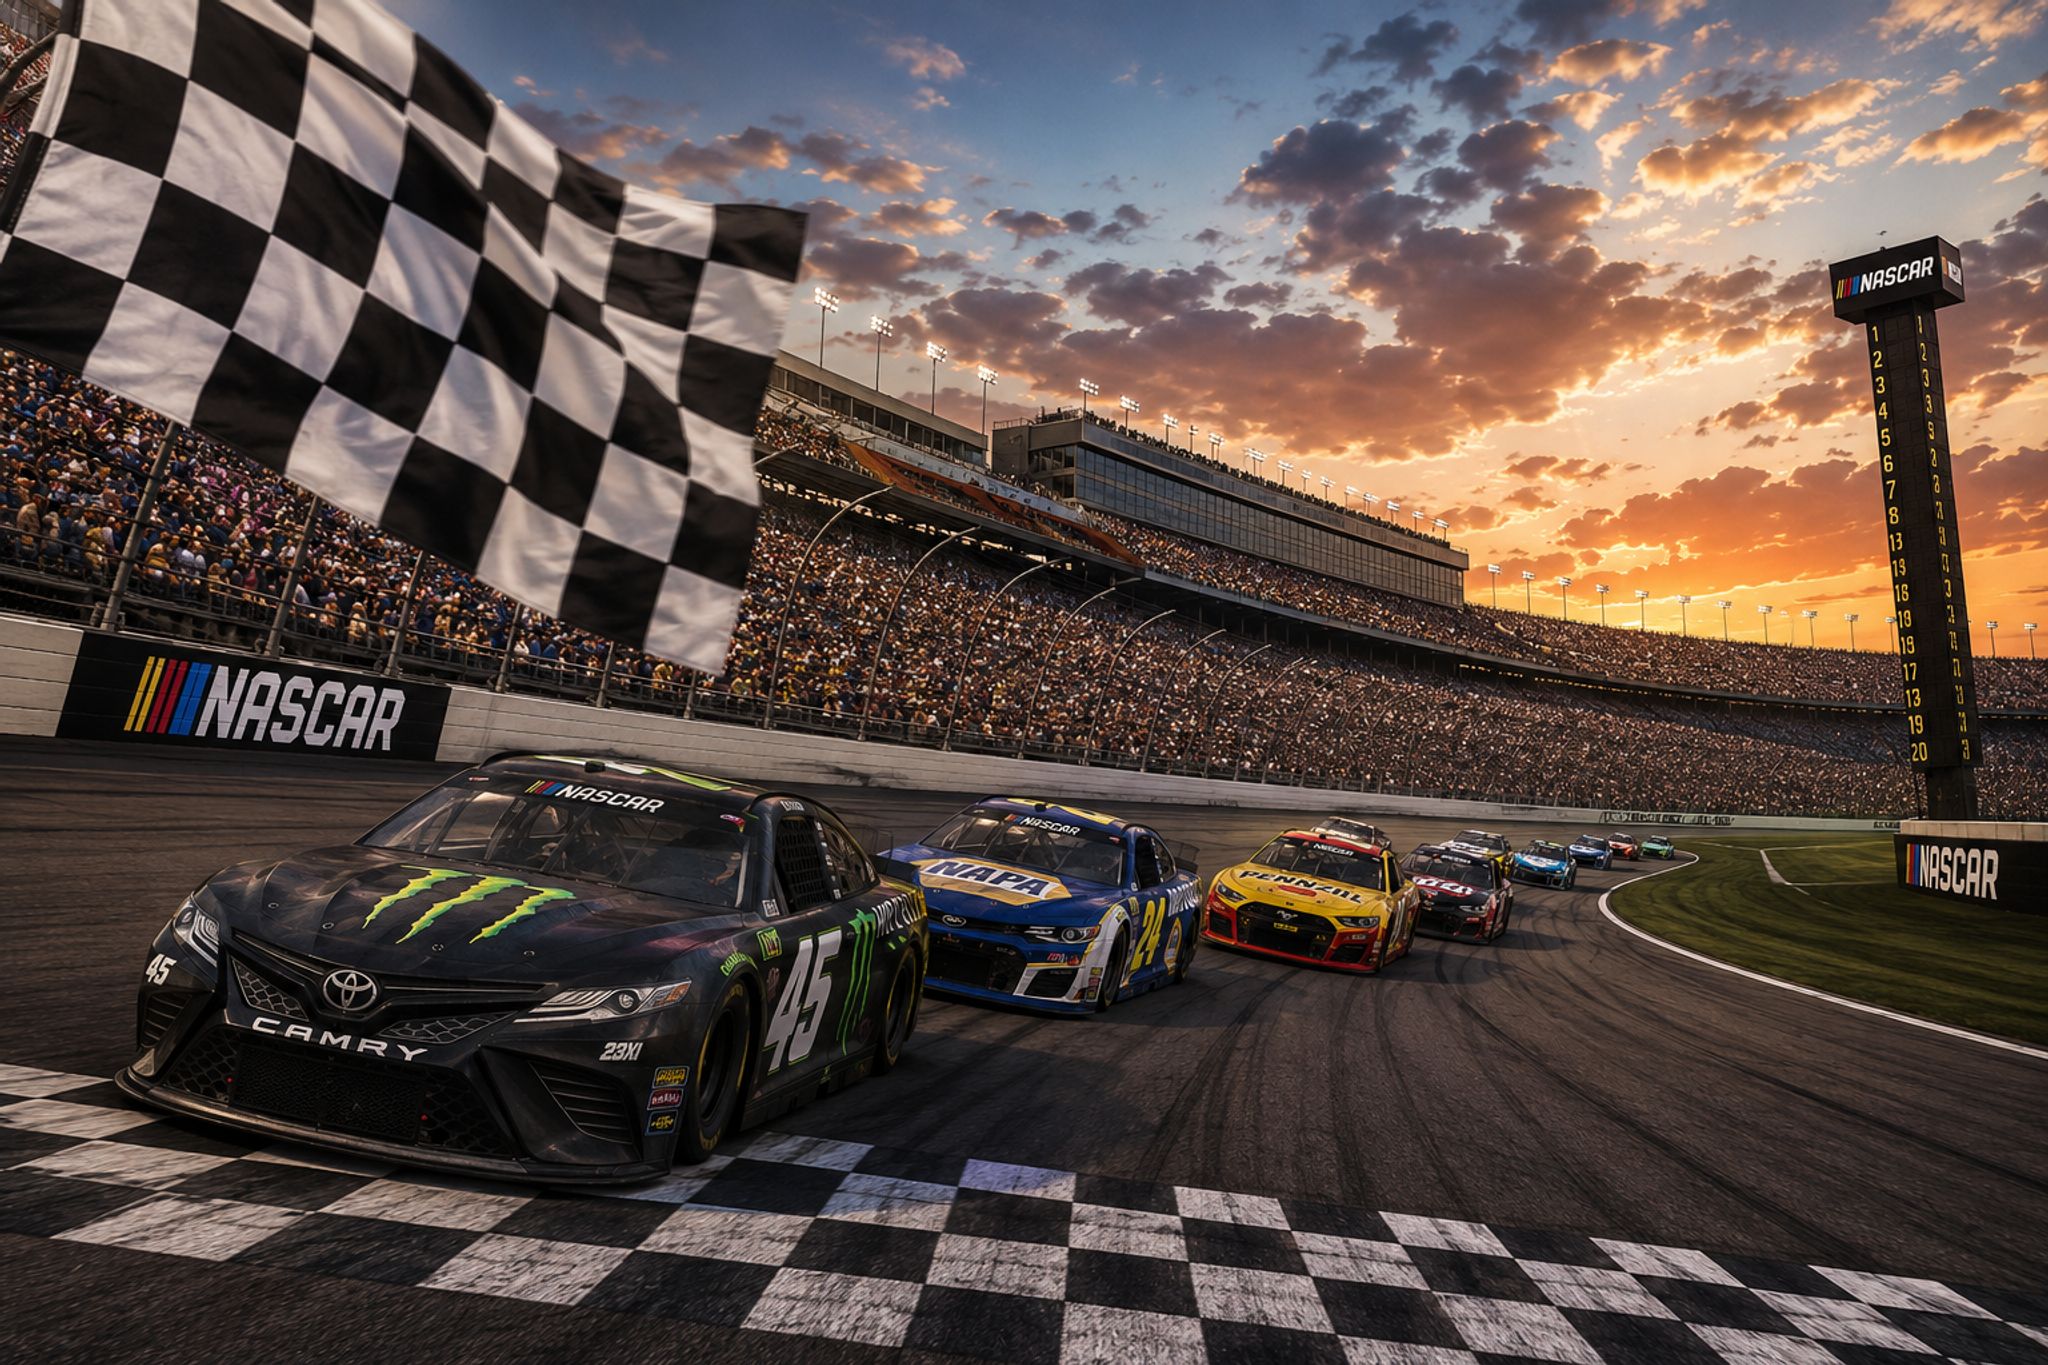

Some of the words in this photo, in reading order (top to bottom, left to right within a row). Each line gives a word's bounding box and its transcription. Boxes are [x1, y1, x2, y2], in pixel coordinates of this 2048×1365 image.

[1860, 256, 1934, 293] NASCAR
[1872, 326, 1879, 342] 1
[1873, 350, 1883, 369] 2
[1875, 376, 1886, 394] 3
[1878, 402, 1888, 420] 4
[1881, 428, 1891, 447] 5
[1883, 454, 1894, 472] 6
[1886, 479, 1896, 500] 7
[1888, 506, 1899, 525] 8
[1889, 532, 1903, 552] 13
[1898, 609, 1912, 628] 18
[1903, 662, 1917, 681] 17
[194, 664, 406, 751] NASCAR
[1905, 688, 1921, 708] 13
[1908, 714, 1924, 735] 19
[1911, 742, 1928, 762] 20
[555, 784, 665, 814] NASCAR
[927, 861, 1049, 896] NAPA
[1919, 844, 1999, 900] NASCAR
[1130, 897, 1166, 971] 24
[145, 953, 178, 986] 45
[764, 926, 842, 1073] 45
[251, 1016, 428, 1062] CAMRY
[599, 1042, 643, 1062] 23XI
